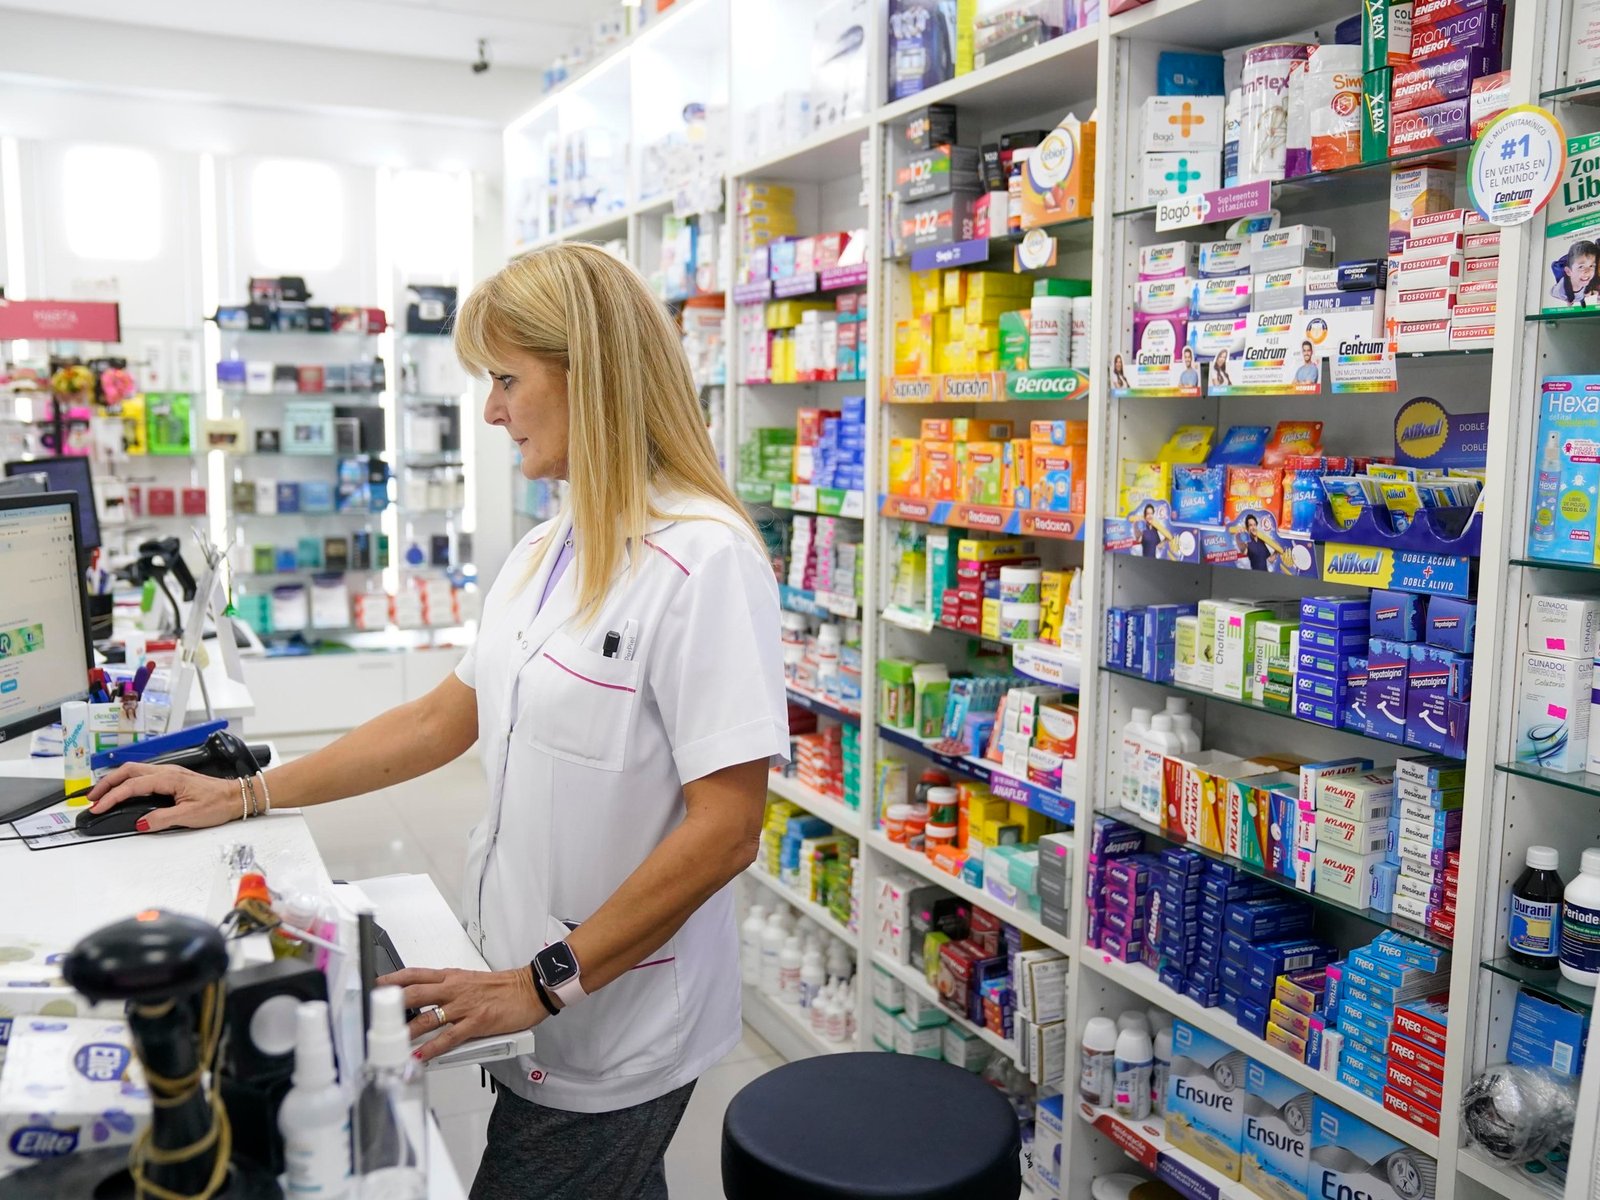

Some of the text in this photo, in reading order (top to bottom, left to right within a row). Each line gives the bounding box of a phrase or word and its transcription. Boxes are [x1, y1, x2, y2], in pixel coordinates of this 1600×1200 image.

[1414, 0, 1451, 17] ENERGY
[1372, 13, 1386, 40] RAY
[1412, 13, 1482, 47] Framintrol
[1411, 37, 1451, 58] ENERGY
[1393, 54, 1468, 86] Framintrol
[1395, 78, 1436, 98] ENERGY
[1372, 107, 1386, 134] RAY
[1393, 105, 1466, 134] Framintrol
[1393, 127, 1435, 145] ENERGY
[1492, 118, 1547, 141] MULTIVITAMÍNICO
[1501, 134, 1530, 160] #1
[909, 158, 932, 181] 102
[1485, 159, 1546, 179] EN VENTAS EN
[1489, 179, 1499, 188] EL
[1217, 190, 1259, 205] Suplementos
[1494, 189, 1533, 204] Centrum
[1160, 200, 1190, 223] Bagó
[1217, 198, 1258, 214] vitamínicos
[914, 211, 938, 236] 102
[1416, 212, 1456, 225] FOSFOVITA
[1263, 231, 1290, 243] Centrum
[1409, 236, 1449, 247] FOSFOVITA
[1150, 247, 1174, 257] Centrum
[1211, 243, 1242, 253] Centrum
[1402, 258, 1442, 271] FOSFOVITA
[1206, 279, 1236, 289] Centrum
[1265, 271, 1292, 283] Centrum
[1148, 283, 1175, 293] Centrum
[1402, 291, 1441, 302] FOSFOVITA
[1307, 299, 1334, 310] BIOZINC
[1455, 307, 1490, 315] FOSFOVITA
[1204, 322, 1234, 332] Centrum
[1258, 313, 1293, 326] Centrum
[1402, 322, 1441, 333] FOSFOVITA
[1453, 328, 1488, 337] FOSFOVITA
[1245, 347, 1287, 360] Centrum
[1339, 341, 1384, 356] Centrum
[1138, 353, 1171, 365] Centrum
[892, 380, 931, 397] Supradyn
[946, 378, 990, 396] Supradyn
[1015, 376, 1077, 394] Berocca
[1549, 393, 1599, 413] Hexa
[1401, 420, 1442, 442] Alikal
[1459, 422, 1485, 431] DOBLE
[1230, 433, 1258, 444] UVASAL
[1280, 429, 1311, 443] UVASAL
[1461, 443, 1487, 452] DOBLE
[1539, 481, 1557, 490] Hexa
[1386, 488, 1406, 500] Alikal
[899, 502, 928, 516] Redoxon
[1180, 496, 1206, 508] UVASAL
[1234, 499, 1263, 511] UVASAL
[968, 510, 1000, 526] Redoxon
[1034, 516, 1071, 533] Redoxon
[1203, 536, 1227, 546] UVASAL
[1327, 551, 1384, 575] Alikal
[1402, 553, 1456, 568] DOBLE ACCIÓN
[1402, 576, 1454, 591] DOBLE ALIVIO
[1537, 600, 1568, 611] CLINADOL
[1584, 611, 1593, 653] CLINADOL
[1216, 619, 1226, 665] Chofitol
[1041, 664, 1060, 677] horas
[1254, 645, 1264, 684] Chofitol
[1528, 658, 1567, 672] CLINADOL
[1369, 669, 1402, 681] Hepatalgina
[1410, 677, 1447, 689] Hepatalgina
[1402, 767, 1424, 781] Resaquit
[993, 784, 1028, 802] ANAFLEX
[1324, 785, 1356, 799] MYLANTA
[1403, 788, 1427, 801] Resaquit
[1189, 781, 1199, 839] MYLANTA
[1406, 808, 1431, 821] Resaquit
[1230, 793, 1240, 853] MYLANTA
[1324, 816, 1356, 832] MYLANTA
[1405, 827, 1430, 841] Resaquit
[1403, 846, 1427, 860] Resaquit
[1323, 857, 1356, 875] MYLANTA
[1401, 883, 1426, 898] Resaquit
[1397, 903, 1422, 918] Resaquit
[1514, 897, 1552, 917] Duranil
[1433, 919, 1452, 931] Rennie
[1378, 943, 1402, 957] TREG
[1354, 957, 1374, 971] TREG
[1348, 972, 1367, 986] TREG
[1348, 986, 1367, 1001] TREG
[1344, 1005, 1363, 1020] TREG
[1342, 1021, 1360, 1037] TREG
[1396, 1014, 1421, 1033] TREG
[1349, 1038, 1367, 1054] TREG
[1390, 1041, 1415, 1061] TREG
[1346, 1055, 1364, 1071] TREG
[1342, 1072, 1360, 1087] TREG
[1388, 1067, 1413, 1087] TREG
[1175, 1078, 1233, 1113] Ensure
[1385, 1092, 1408, 1112] TREG
[17, 1131, 73, 1152] Elite
[1247, 1117, 1305, 1158] Ensure
